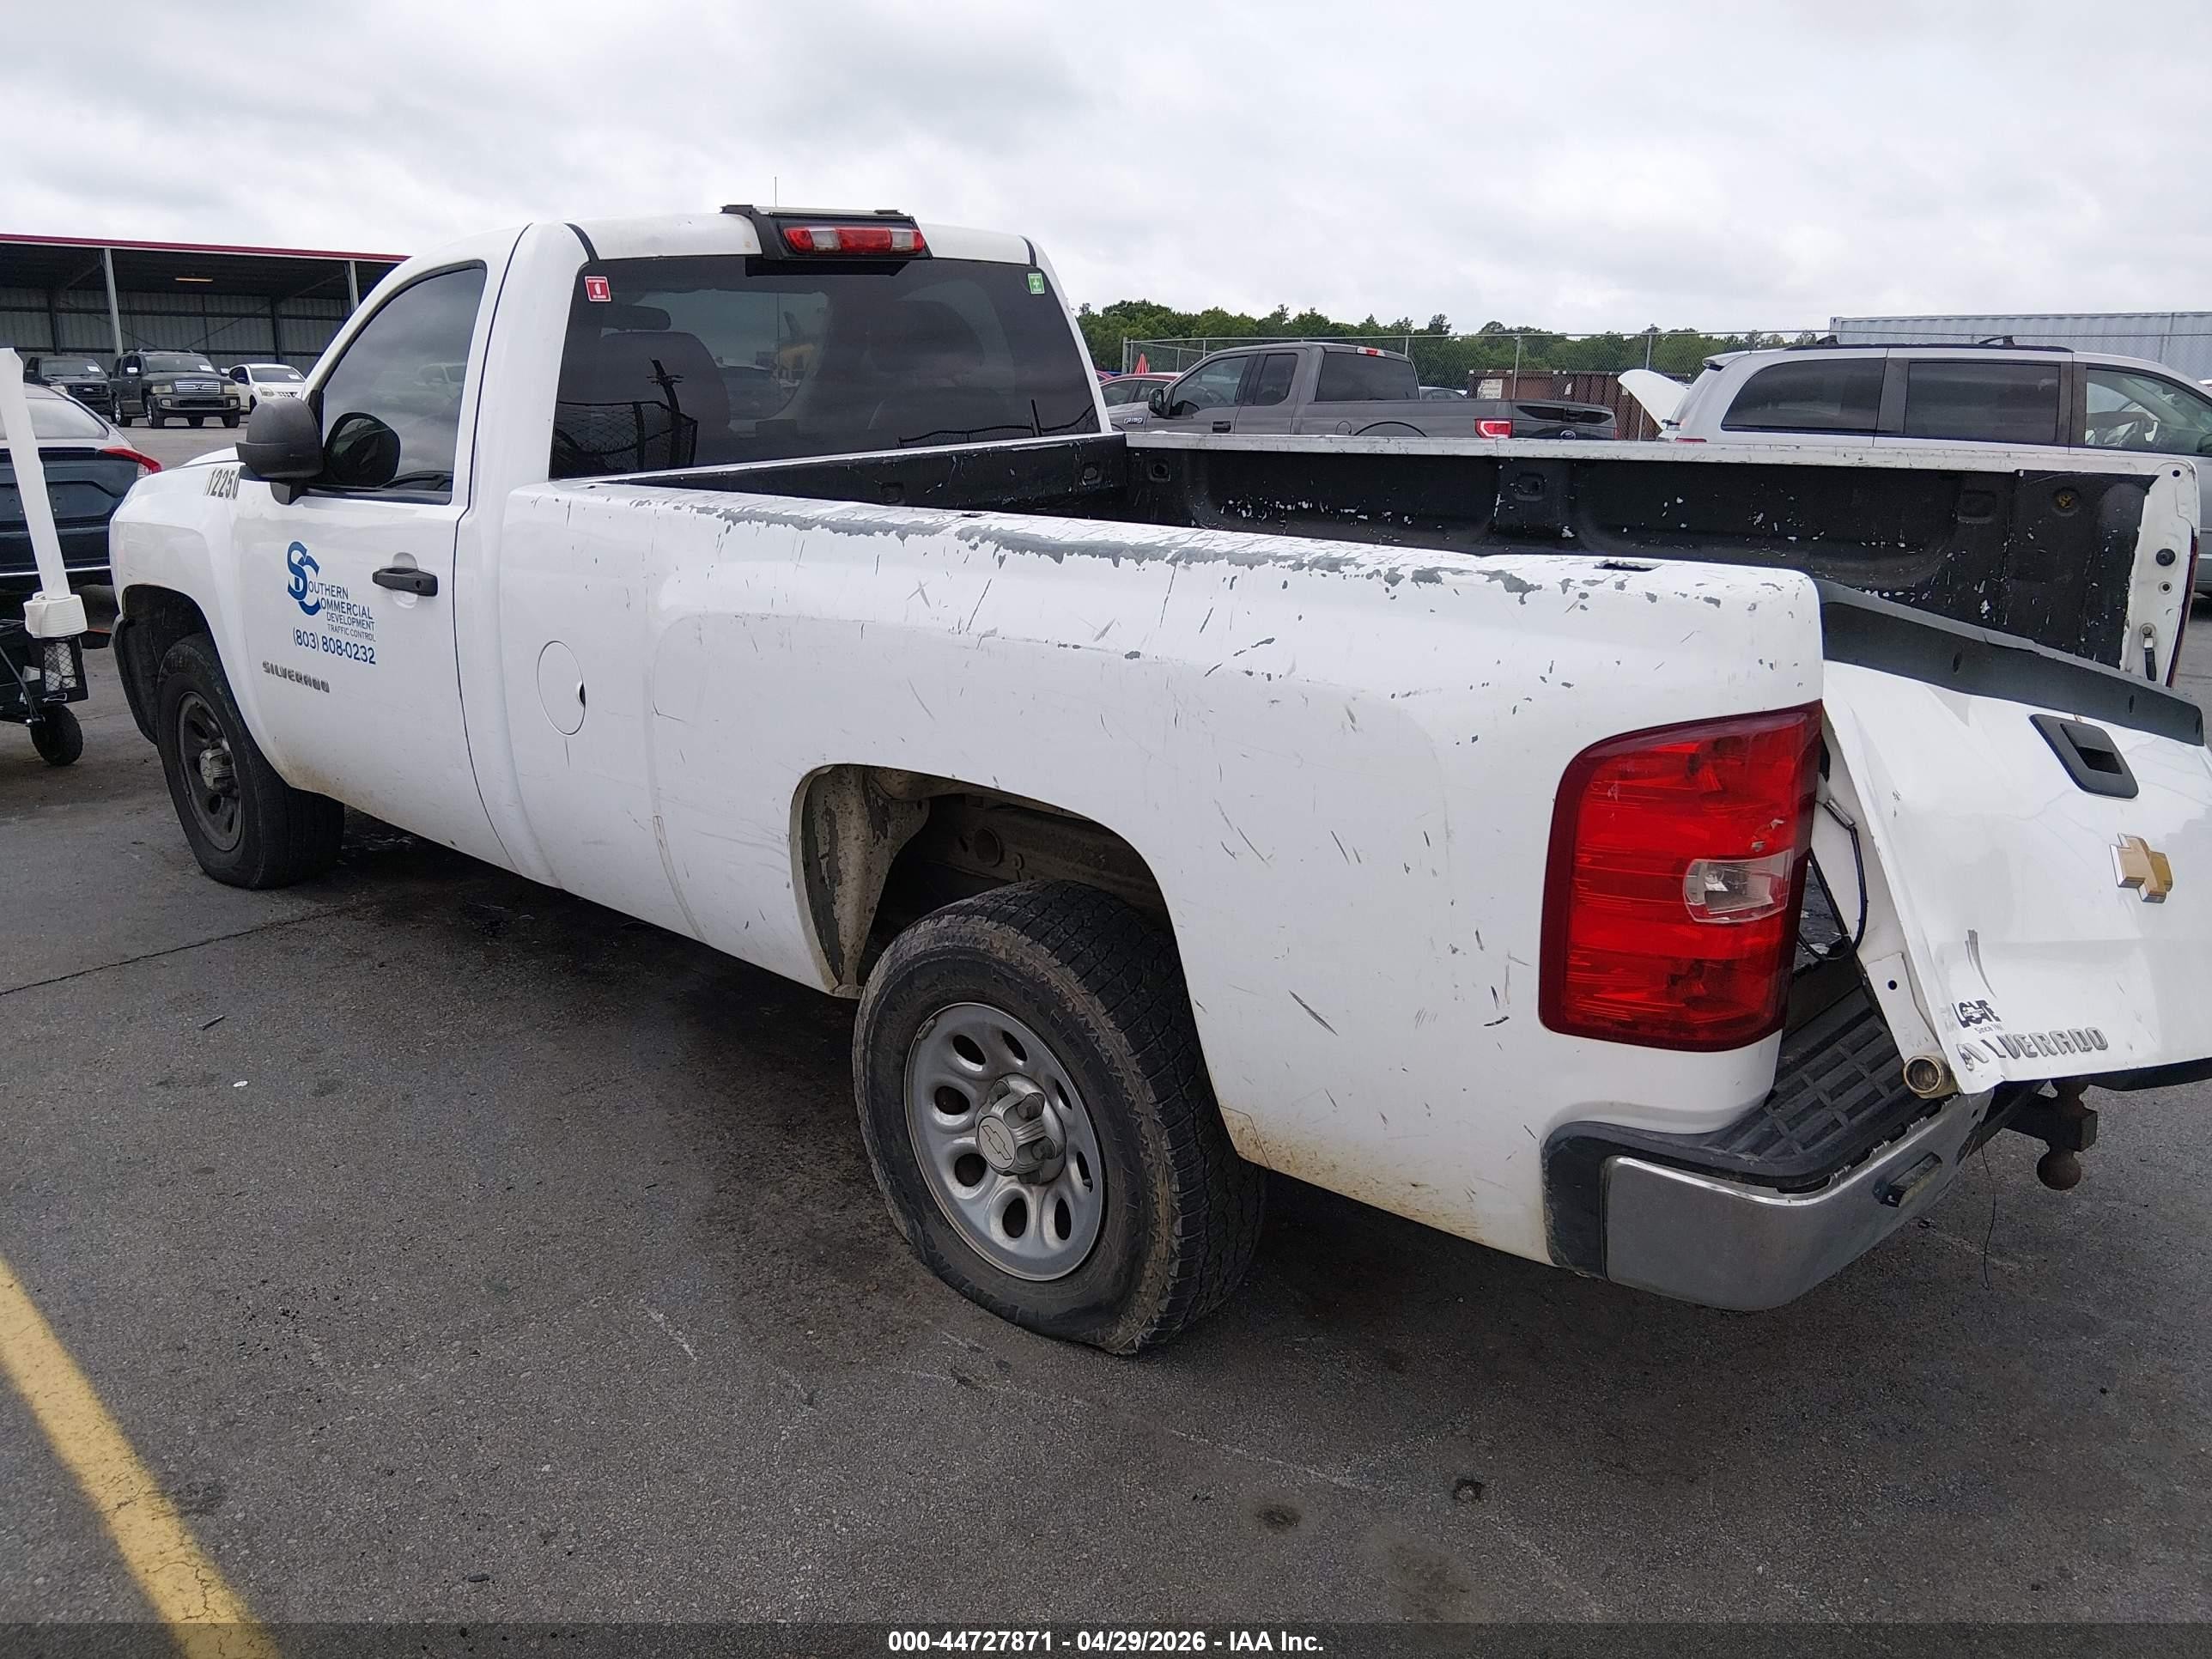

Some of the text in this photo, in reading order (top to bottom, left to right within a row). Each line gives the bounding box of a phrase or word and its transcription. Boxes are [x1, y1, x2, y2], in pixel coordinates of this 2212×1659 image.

[206, 468, 240, 499] 12250
[326, 612, 374, 631] DEVELOPMENT
[327, 623, 376, 642] TRAFFIC CONTROL
[293, 626, 376, 665] (803) 808-0232
